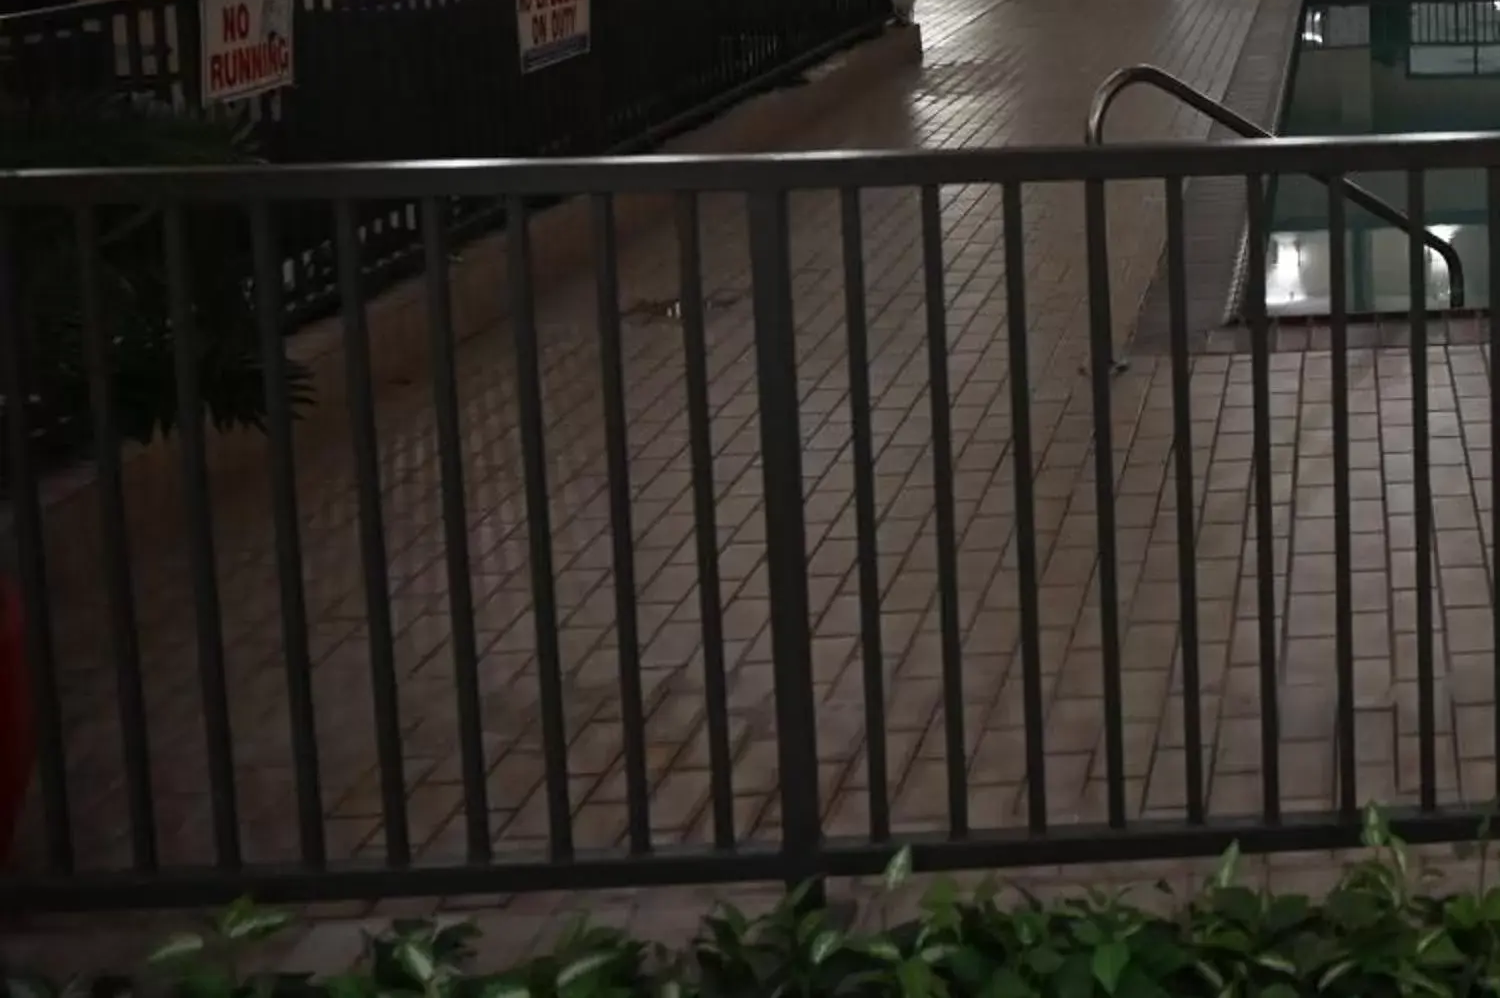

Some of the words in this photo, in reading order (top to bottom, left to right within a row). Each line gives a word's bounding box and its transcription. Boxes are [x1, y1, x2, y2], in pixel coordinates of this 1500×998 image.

[222, 3, 250, 43] NO
[531, 12, 547, 45] ON
[551, 6, 577, 39] DUTY
[210, 35, 289, 93] RUNNING
